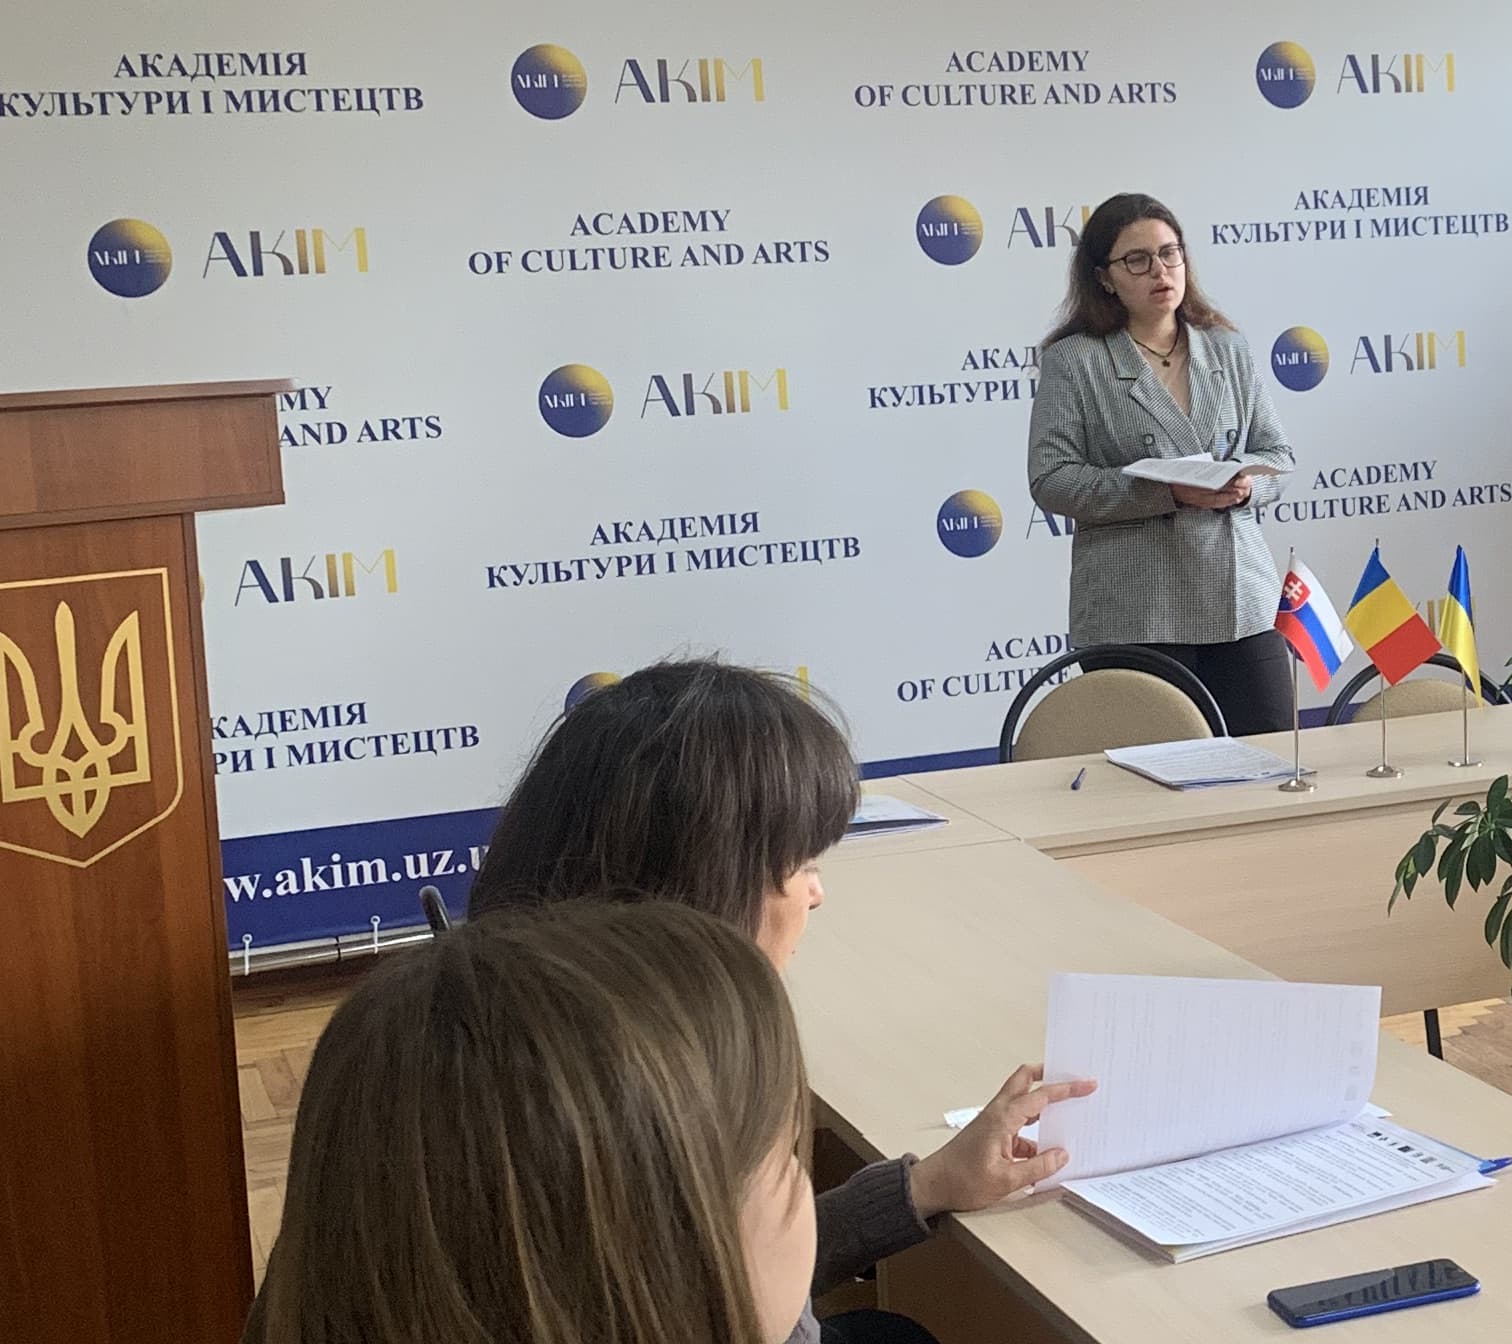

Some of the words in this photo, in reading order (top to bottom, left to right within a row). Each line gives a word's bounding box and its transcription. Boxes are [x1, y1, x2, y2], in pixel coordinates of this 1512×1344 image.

[113, 52, 308, 82] АКАДЕМІЯ
[946, 50, 1090, 73] ACADEMY
[0, 90, 191, 118] КУЛЬТУРИ
[225, 87, 425, 117] МИСТЕЦТВ
[854, 84, 894, 107] OF
[901, 83, 1037, 107] CULTURE
[1043, 82, 1101, 105] AND
[1108, 81, 1178, 104] ARTS
[1294, 186, 1429, 212] АКАДЕМІЯ
[570, 208, 731, 237] ACADEMY
[1211, 218, 1347, 246] КУЛЬТУРИ
[1369, 212, 1510, 239] МИСТЕЦТВ
[468, 250, 513, 275] OF
[520, 244, 673, 273] CULTURE
[680, 242, 744, 267] AND
[751, 239, 830, 264] ARTS
[961, 346, 1040, 372] АКАД
[867, 378, 1021, 409] КУЛЬТУРИ
[279, 421, 347, 447] AND
[357, 415, 442, 443] ARTS
[1312, 460, 1438, 490] ACADEMY
[1274, 494, 1391, 524] CULTURE
[1396, 488, 1447, 512] AND
[1452, 483, 1512, 506] ARTS
[590, 511, 760, 546] АКАДЕМІЯ
[485, 551, 656, 589] КУЛЬТУРИ
[683, 536, 861, 573] МИСТЕЦТВ
[897, 678, 936, 703] OF
[210, 702, 368, 741] КАДЕМІЯ
[286, 725, 480, 767] МИСТЕЦТВ
